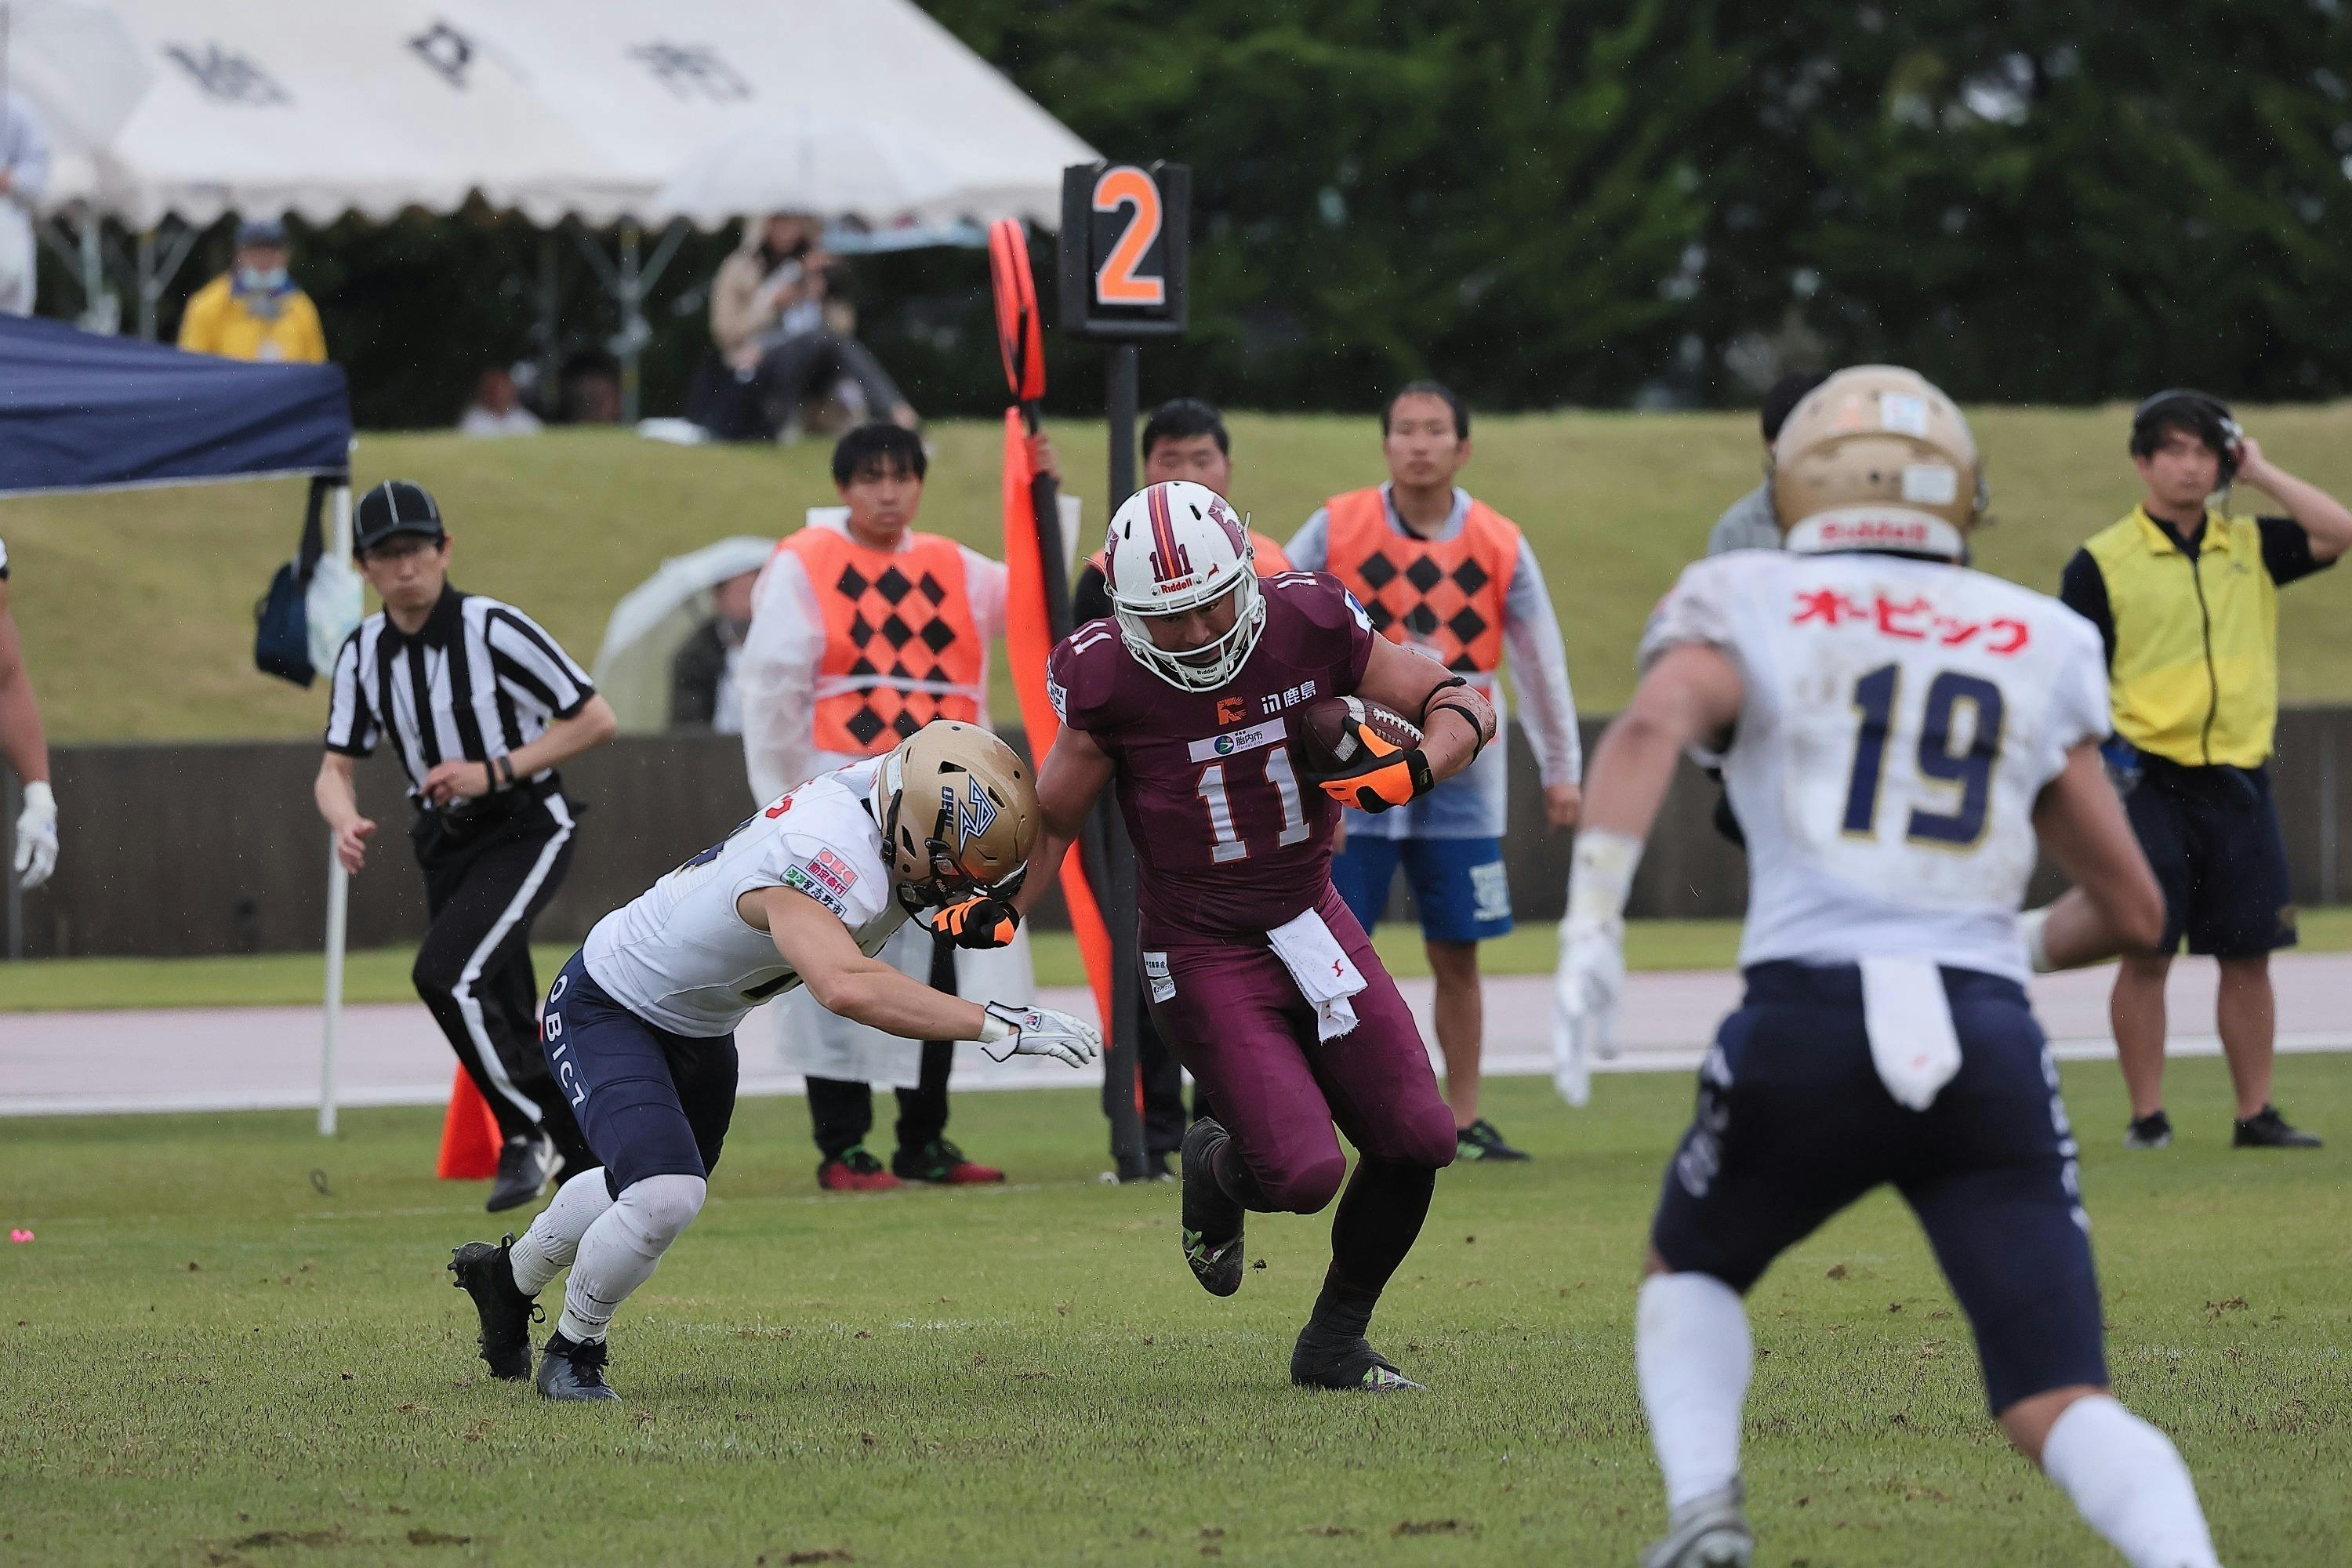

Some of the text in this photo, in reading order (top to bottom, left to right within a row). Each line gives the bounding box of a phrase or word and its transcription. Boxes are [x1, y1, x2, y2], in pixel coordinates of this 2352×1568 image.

[1093, 165, 1165, 305] 2
[1160, 578, 1192, 594] Riddell
[1067, 622, 1112, 656] 11
[1791, 587, 2031, 657] オービック
[1196, 666, 1218, 676] Riddell
[1283, 680, 1317, 708] 鹿島
[1236, 731, 1263, 746] 胎内市
[1841, 661, 2008, 855] 19
[1196, 746, 1311, 864] 11
[808, 861, 847, 895] 勘定奉行
[803, 879, 843, 915] 習志野市
